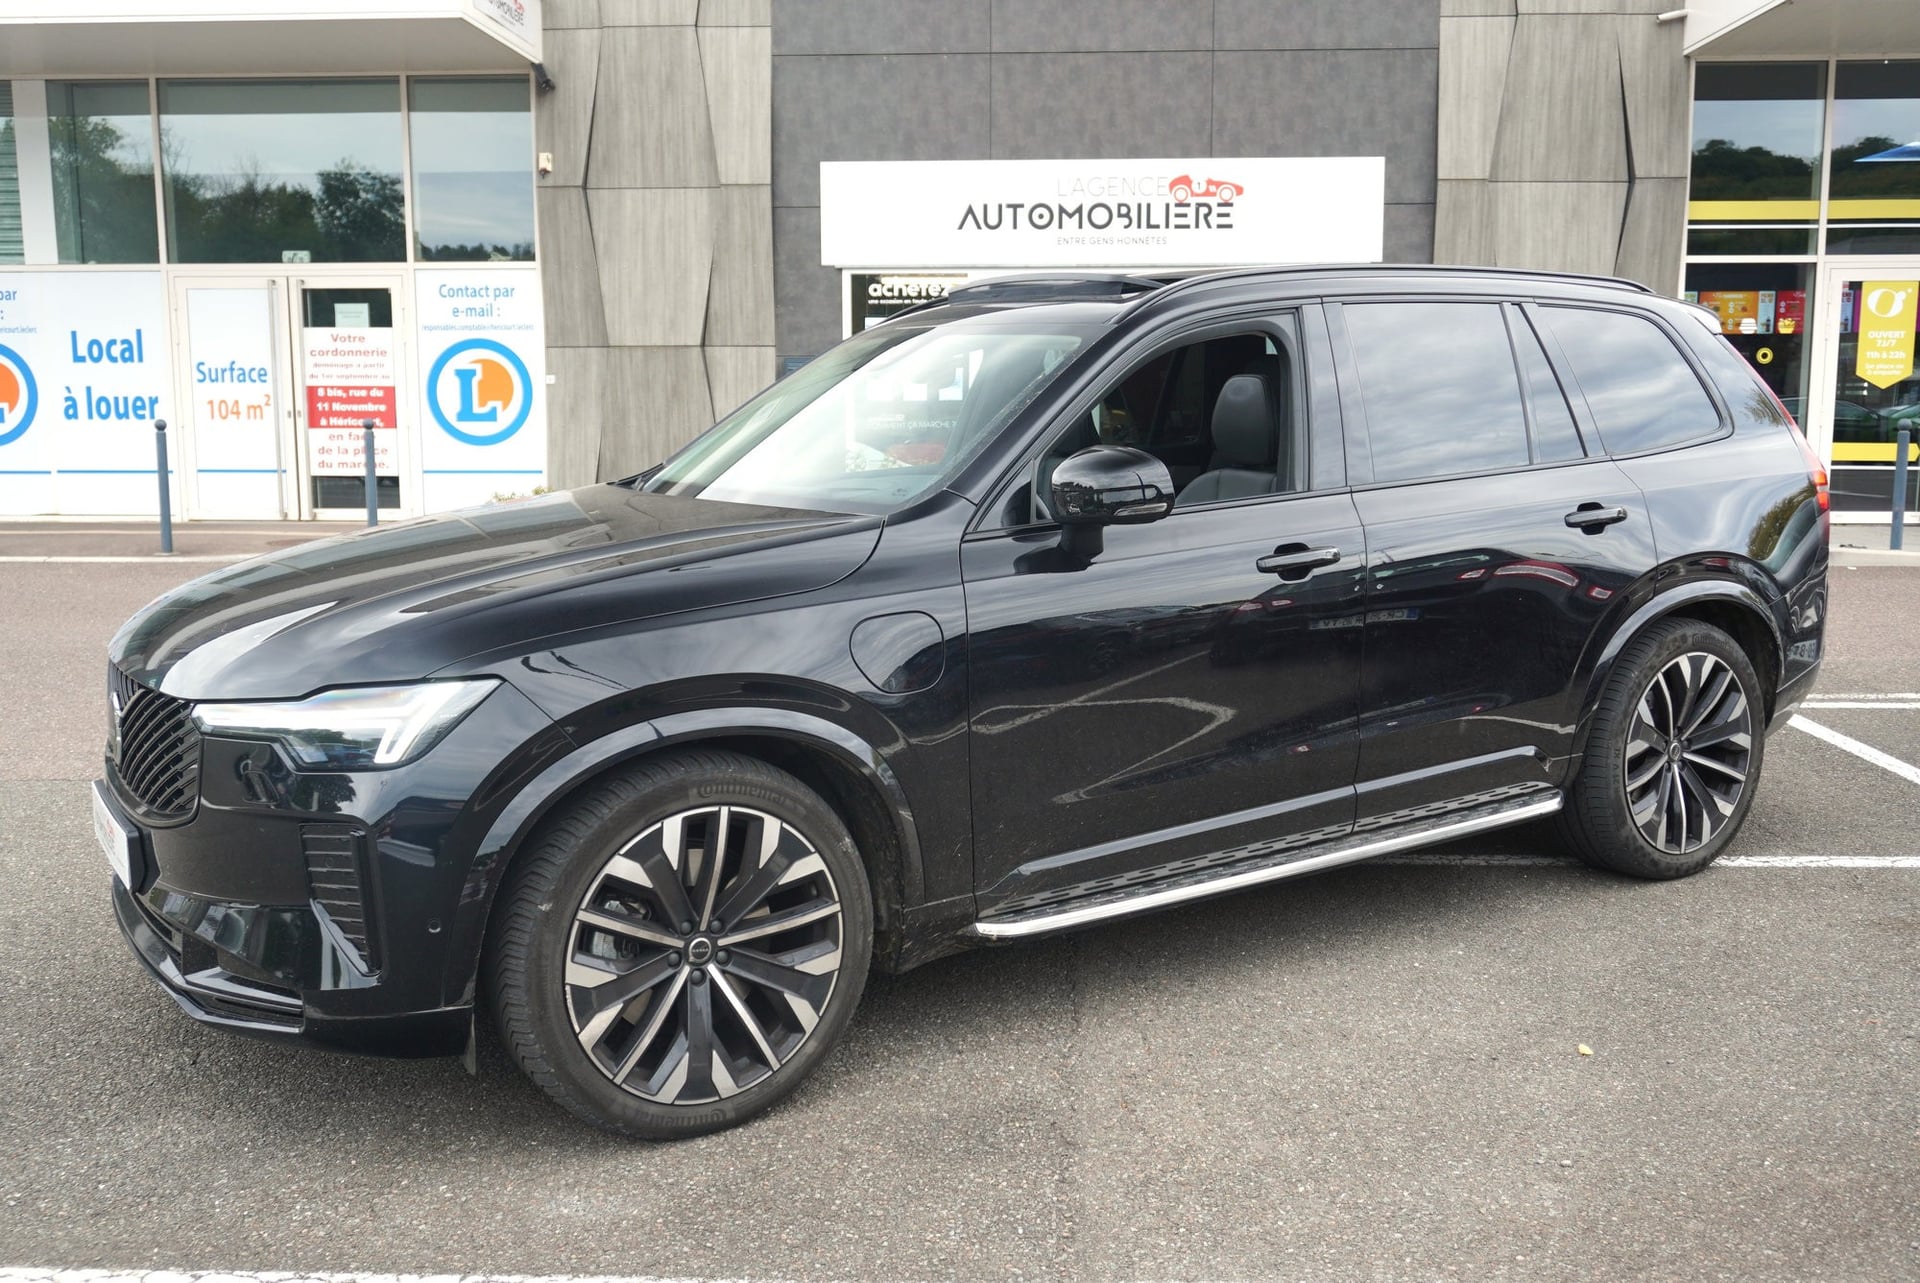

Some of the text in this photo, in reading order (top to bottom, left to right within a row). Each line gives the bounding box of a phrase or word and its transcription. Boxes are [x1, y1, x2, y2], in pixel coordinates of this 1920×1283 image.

[1057, 236, 1086, 245] ENTRE
[1089, 236, 1114, 245] GENS
[438, 283, 515, 301] Contact par
[452, 303, 493, 317] e-mail
[330, 333, 366, 343] Votre
[1868, 330, 1906, 339] OUVERT
[71, 328, 144, 363] Local
[309, 348, 388, 357] cordonnerie
[196, 360, 268, 383] Surface
[348, 389, 368, 397] rue
[369, 387, 384, 397] du
[64, 386, 159, 420] à louer
[316, 402, 387, 412] 11 Novembre
[207, 399, 241, 420] 104
[328, 433, 344, 441] en
[318, 446, 333, 455] de
[337, 446, 349, 455] la
[318, 461, 333, 469] du
